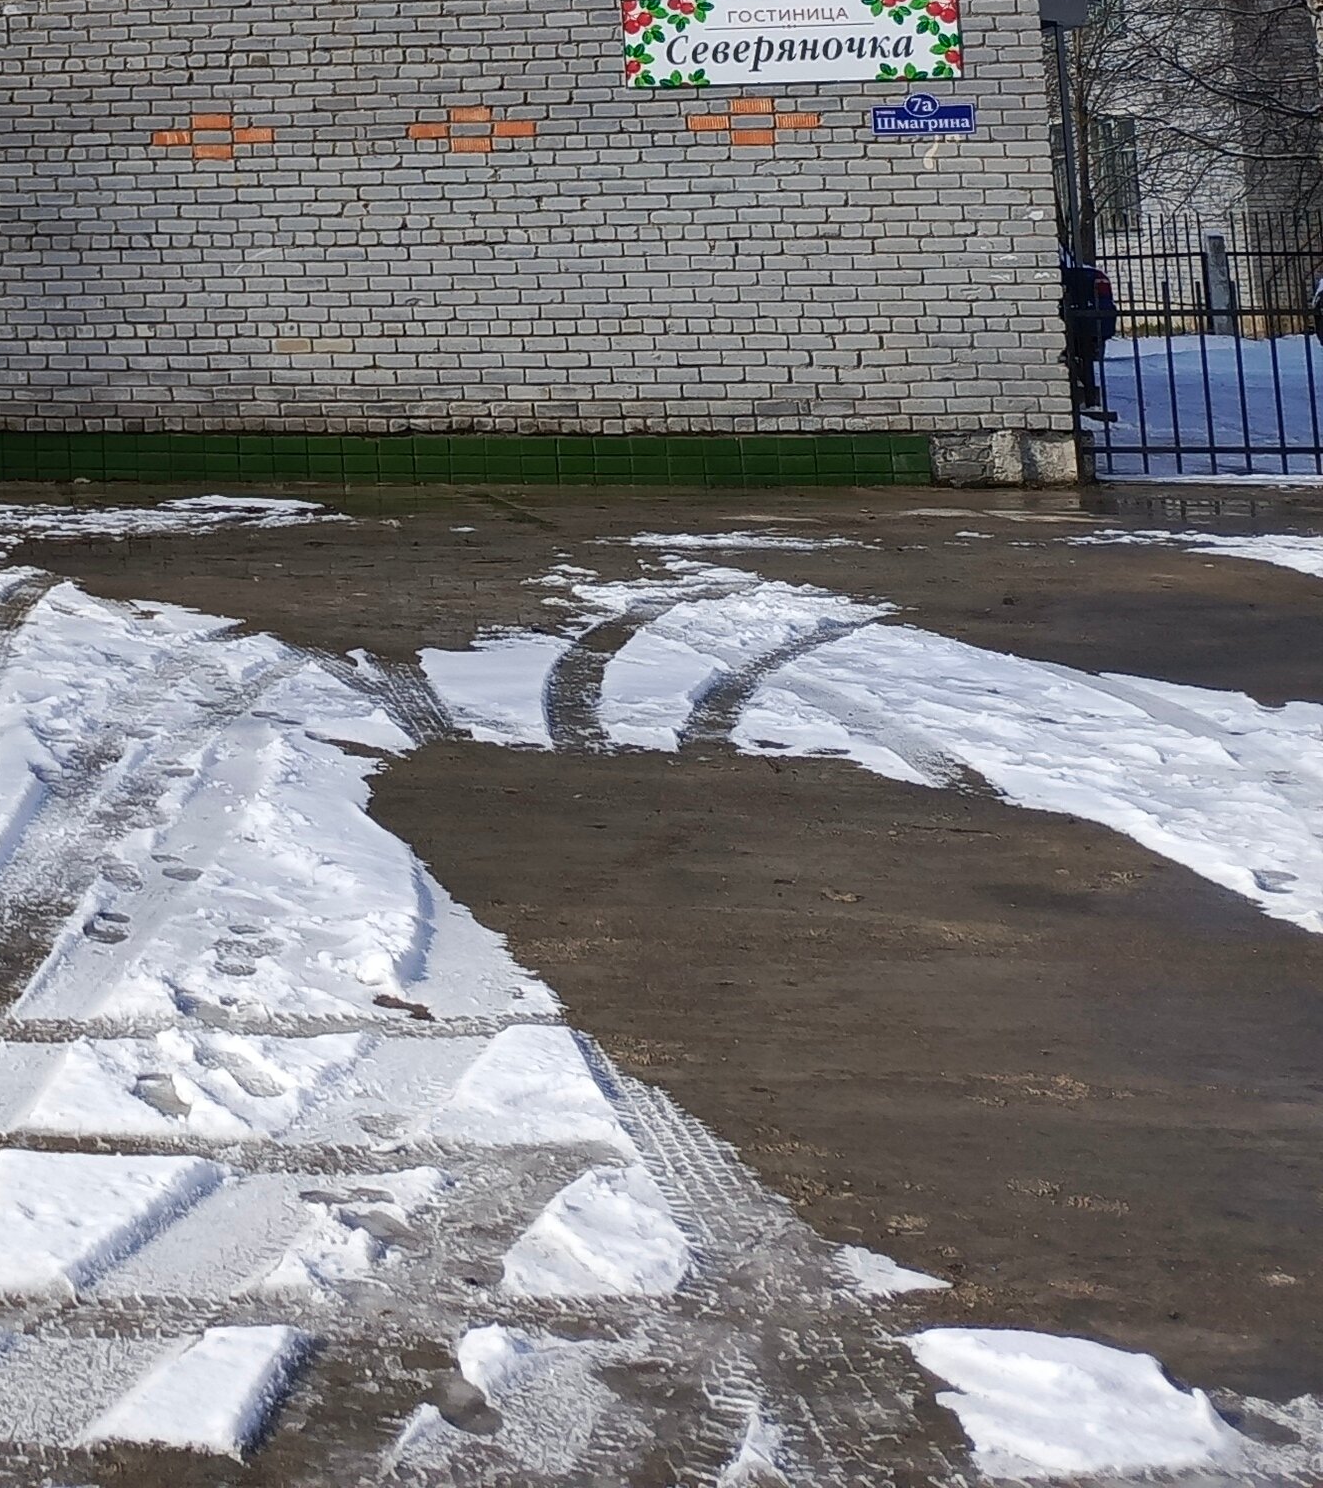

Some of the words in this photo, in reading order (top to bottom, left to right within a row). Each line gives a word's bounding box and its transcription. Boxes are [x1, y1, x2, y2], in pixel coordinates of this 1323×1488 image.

[726, 5, 849, 24] ГОСТИНИЦА
[665, 32, 914, 73] Северяночка
[910, 97, 934, 113] 7а
[876, 116, 971, 131] Шмагрина
